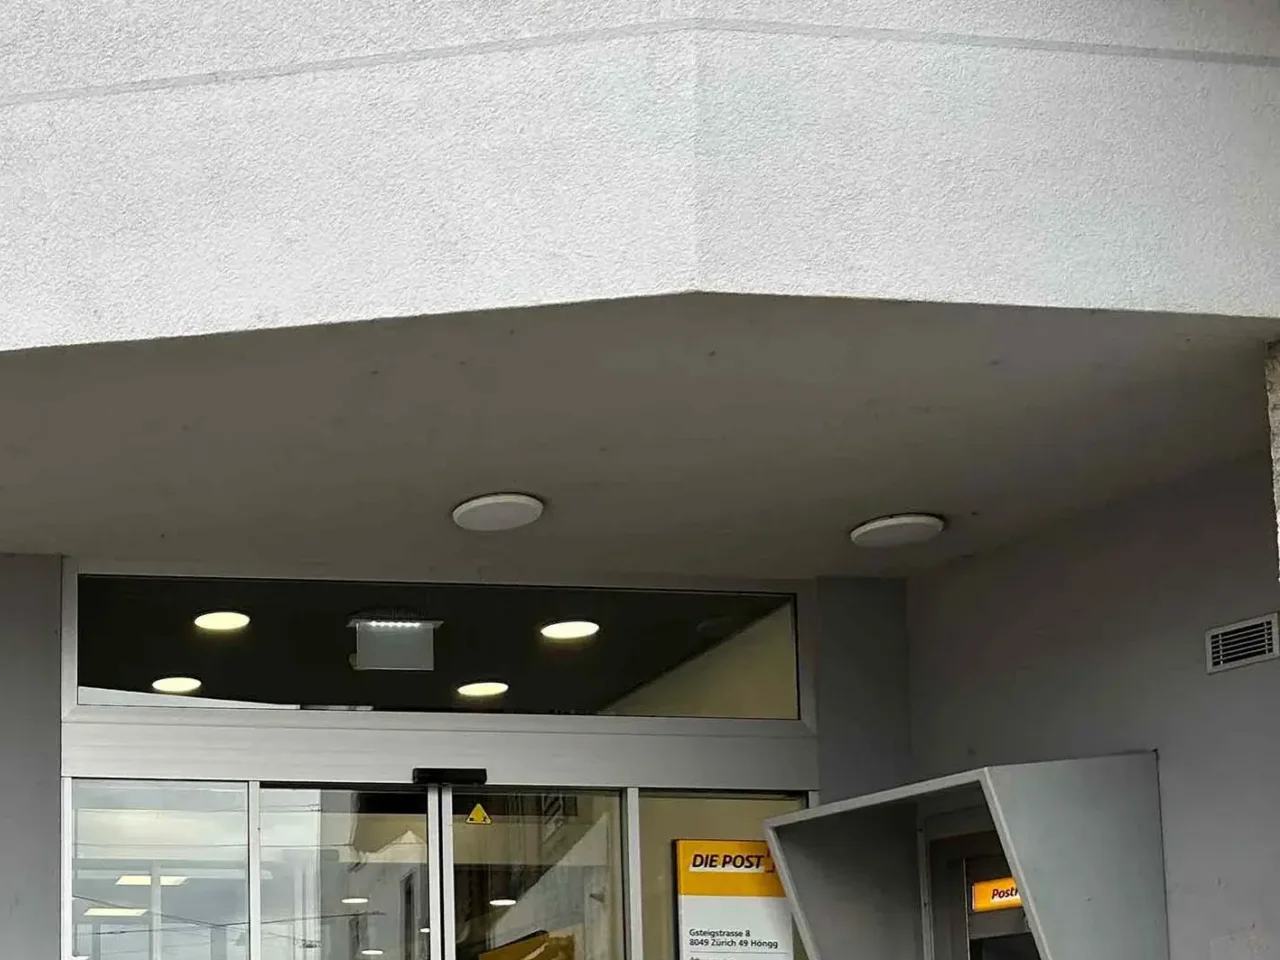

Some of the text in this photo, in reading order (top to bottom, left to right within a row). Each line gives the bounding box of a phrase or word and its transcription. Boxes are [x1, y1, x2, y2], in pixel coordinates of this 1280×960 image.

[692, 854, 764, 868] DIE POST
[689, 929, 743, 937] Gsteigstrasse
